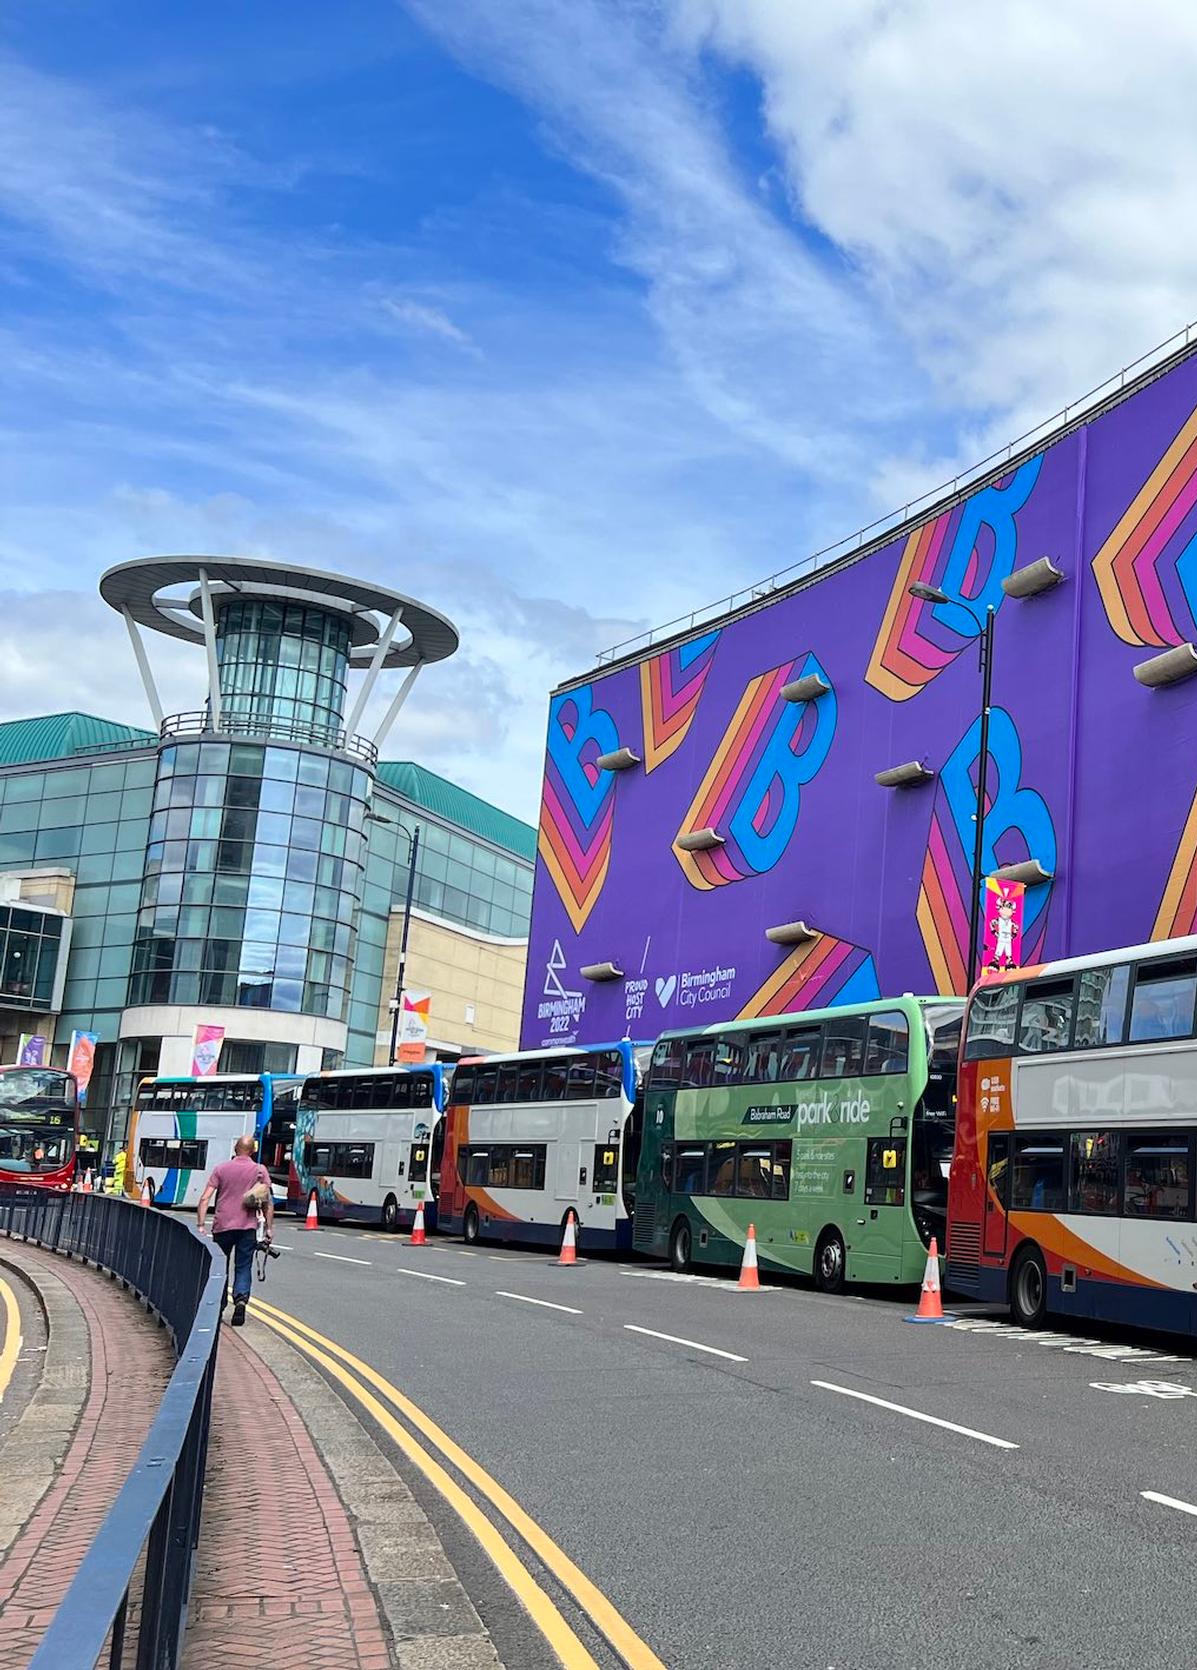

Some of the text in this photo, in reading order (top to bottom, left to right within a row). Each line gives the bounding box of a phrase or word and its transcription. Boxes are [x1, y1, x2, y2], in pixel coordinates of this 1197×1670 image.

[681, 966, 736, 988] Birmingham
[625, 979, 648, 994] PROUD
[626, 992, 645, 1006] HOST
[680, 984, 731, 1008] City Council
[537, 997, 586, 1019] BIRMINGHAM
[626, 1005, 644, 1020] CITY
[550, 1016, 570, 1033] 2022
[750, 1106, 792, 1121] Babraham Road
[797, 1091, 832, 1133] park
[840, 1089, 871, 1124] ride
